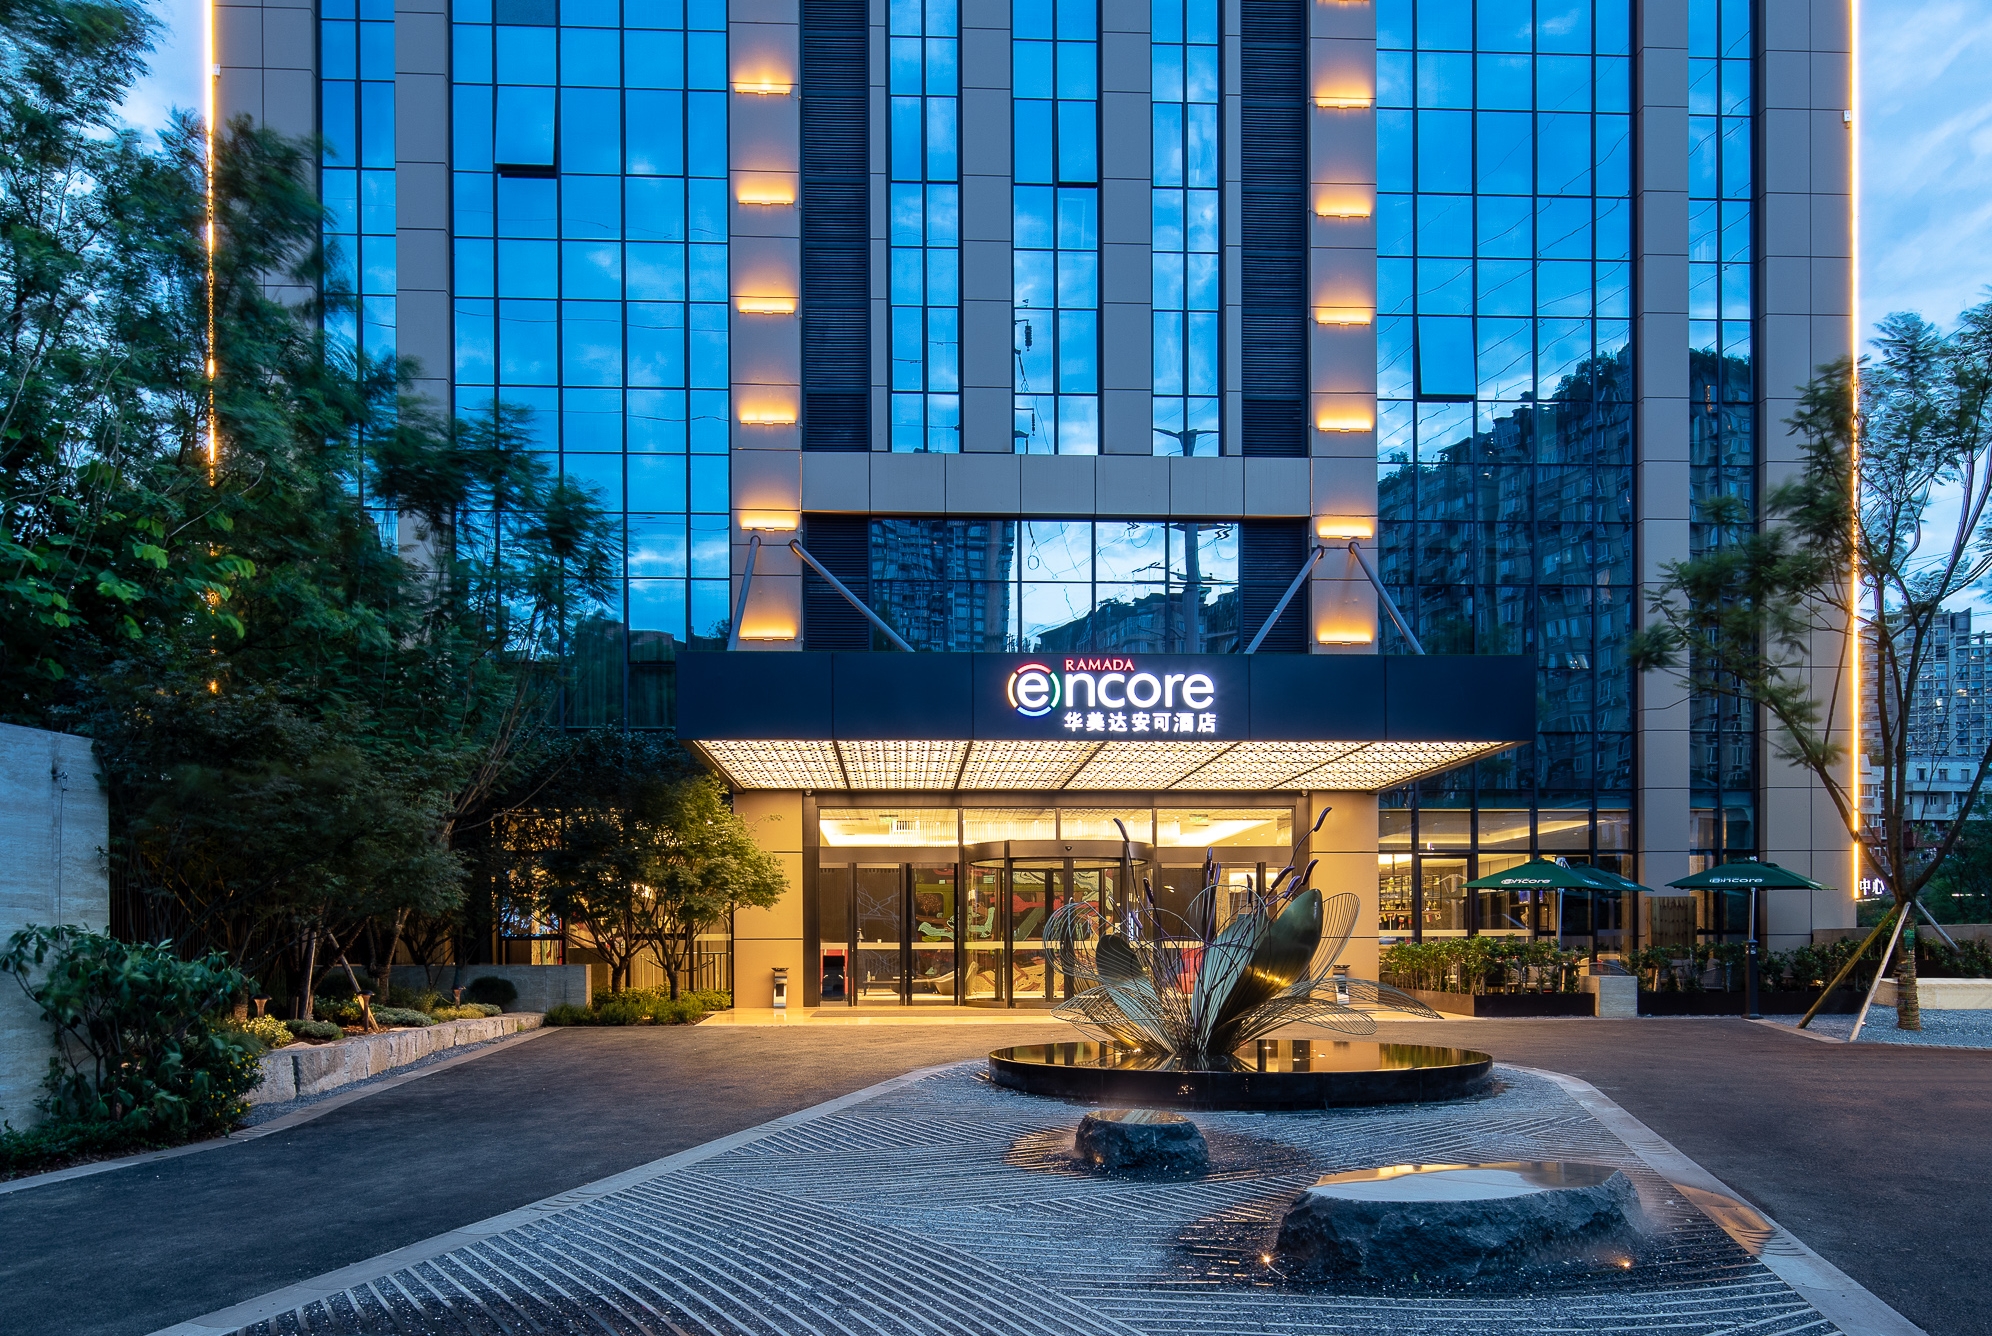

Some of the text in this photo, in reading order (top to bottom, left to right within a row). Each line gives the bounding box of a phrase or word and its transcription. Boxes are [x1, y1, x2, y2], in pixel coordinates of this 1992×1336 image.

[1065, 658, 1135, 671] RAMADA
[1015, 671, 1215, 711] encore
[1064, 712, 1217, 733] 华美达安可酒店
[1859, 877, 1885, 896] 中心
